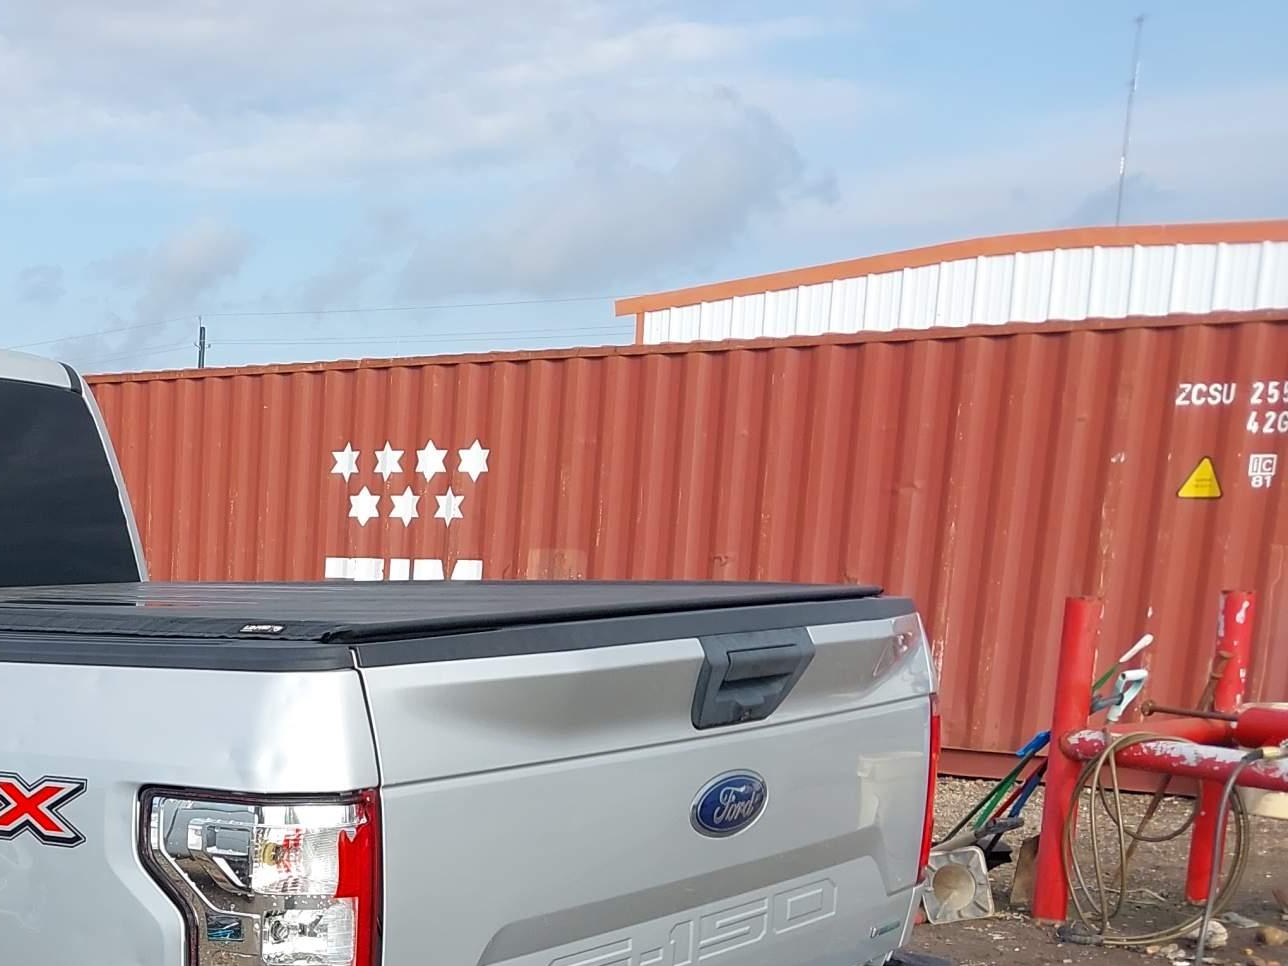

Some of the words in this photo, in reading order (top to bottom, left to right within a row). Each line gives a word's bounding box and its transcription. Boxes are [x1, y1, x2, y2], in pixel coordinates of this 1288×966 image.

[1176, 383, 1237, 406] ZCSU
[1250, 475, 1272, 488] 81
[713, 784, 758, 824] Ford
